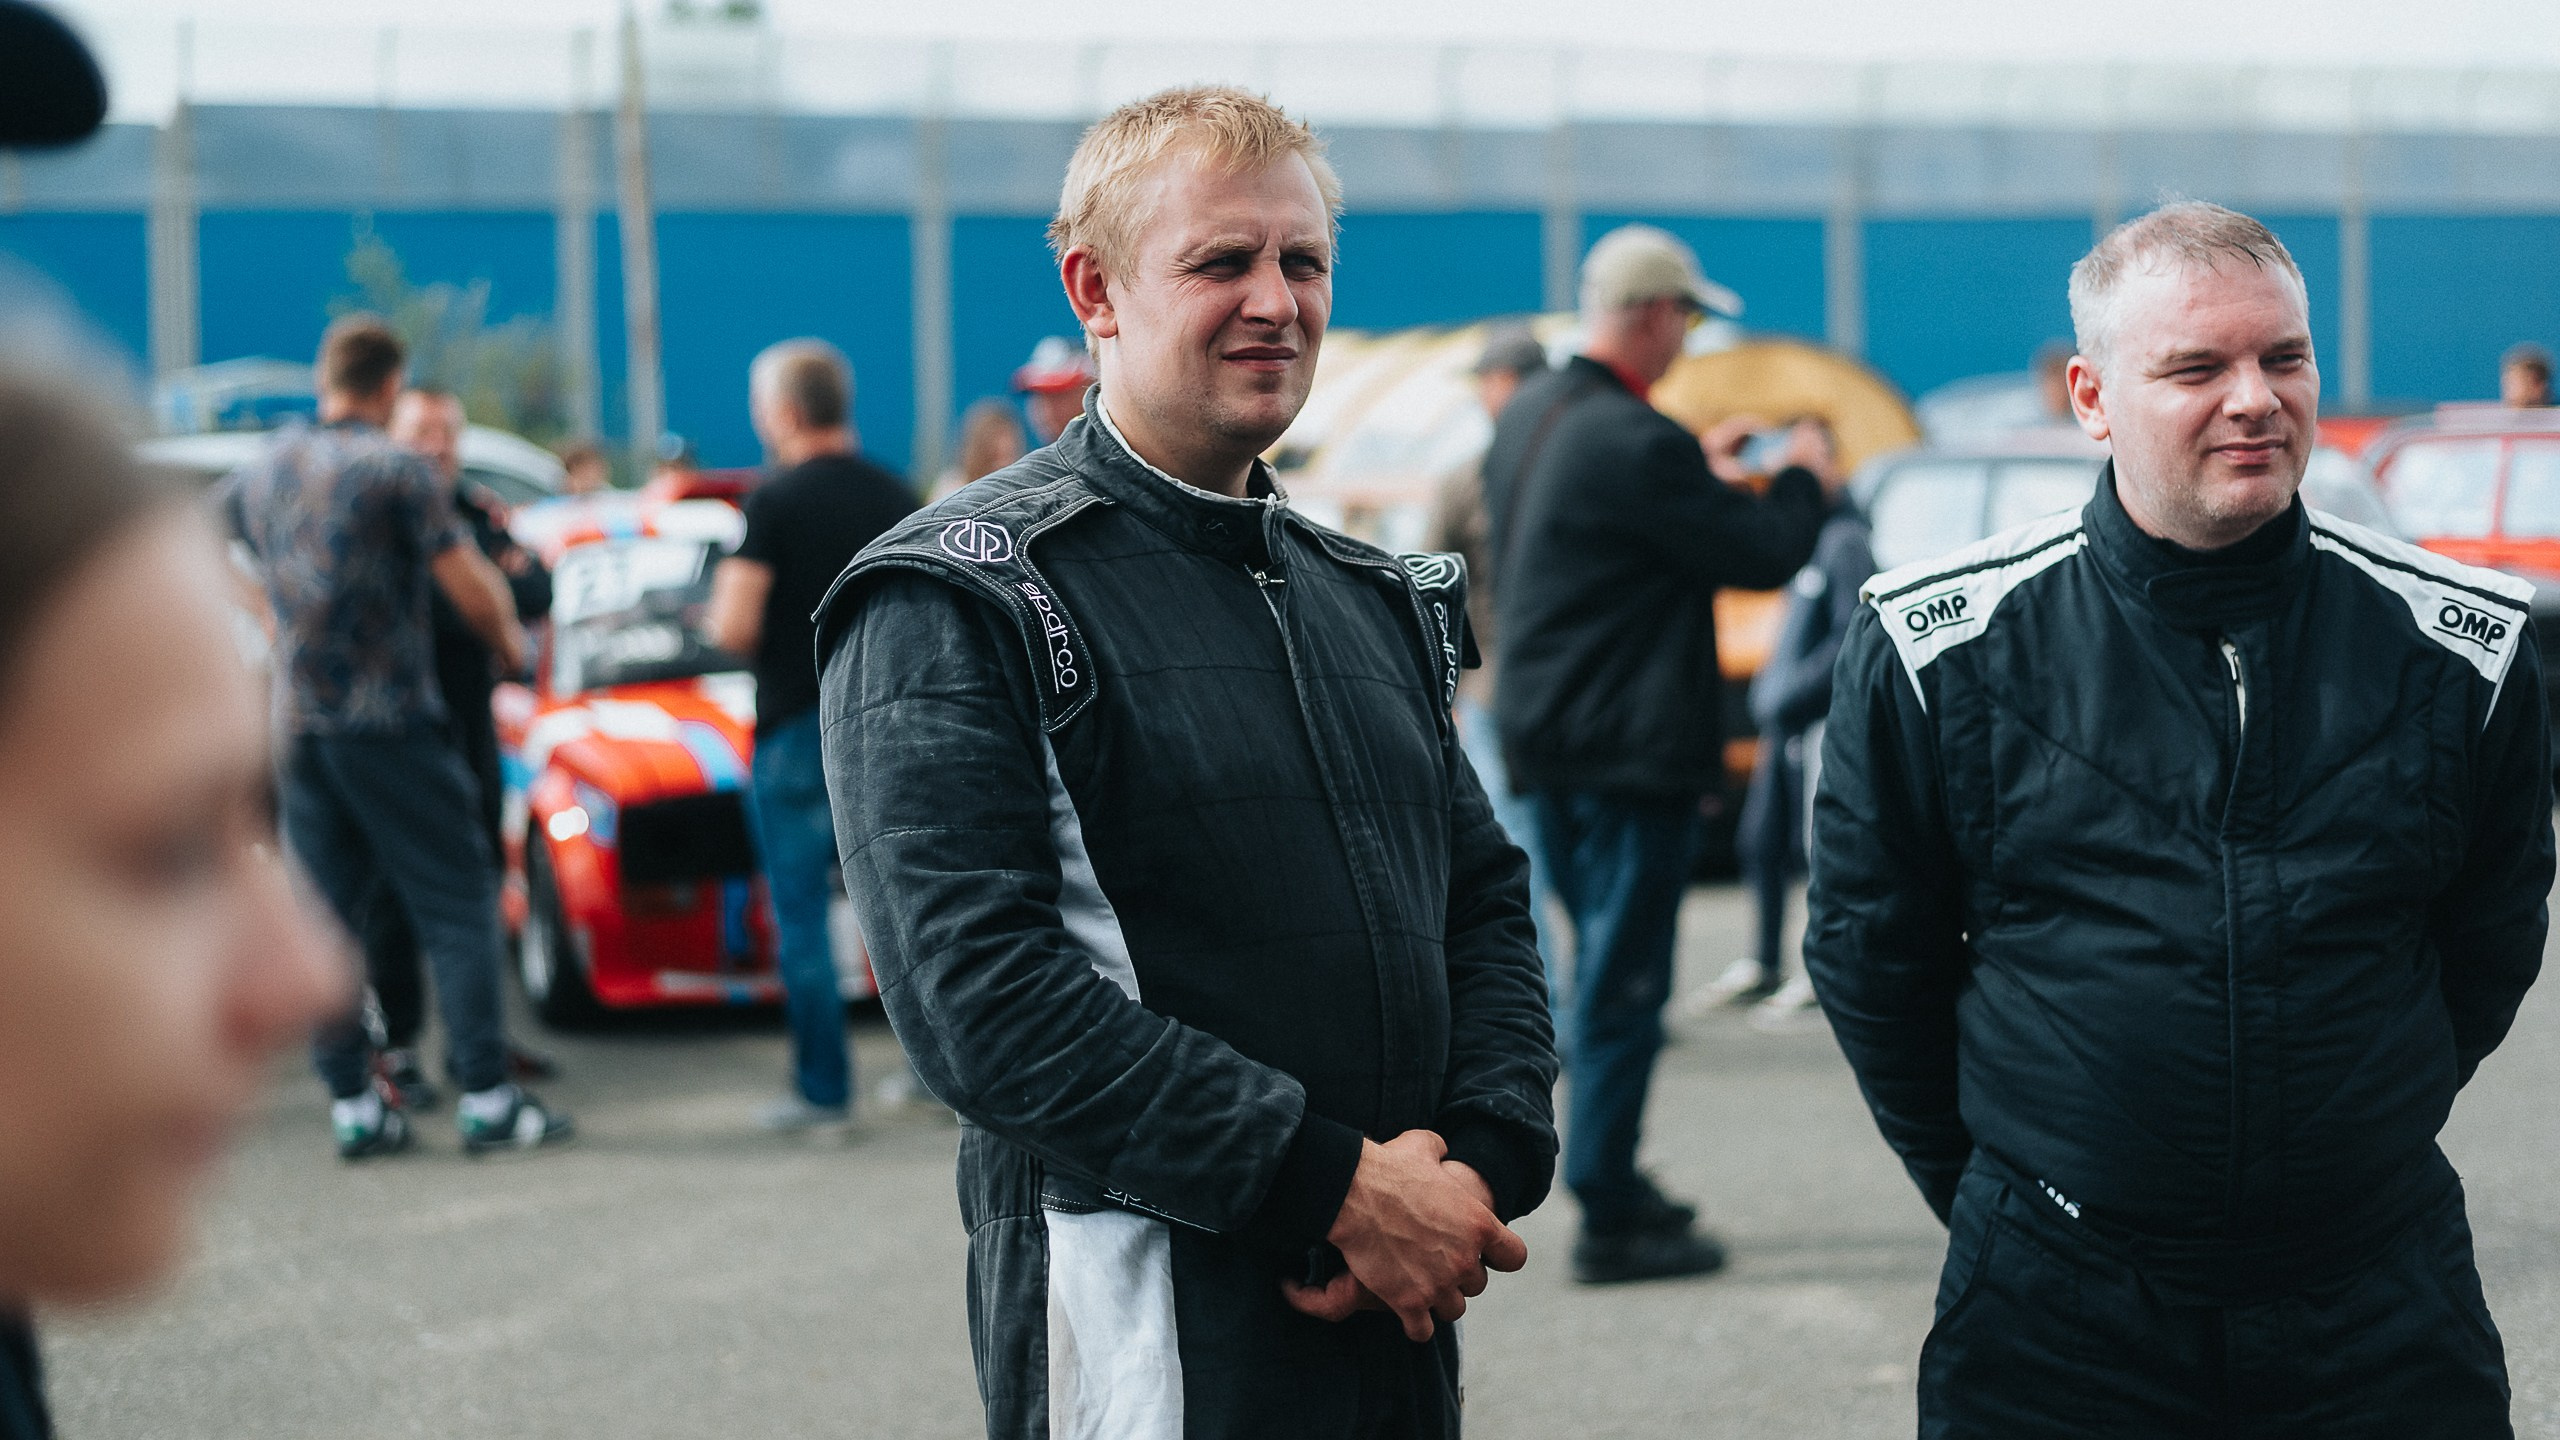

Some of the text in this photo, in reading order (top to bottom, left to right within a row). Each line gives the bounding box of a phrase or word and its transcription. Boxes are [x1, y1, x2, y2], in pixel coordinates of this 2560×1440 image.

[1906, 595, 1967, 632] OMP
[2439, 604, 2506, 645] OMP
[1022, 582, 1078, 688] sparco
